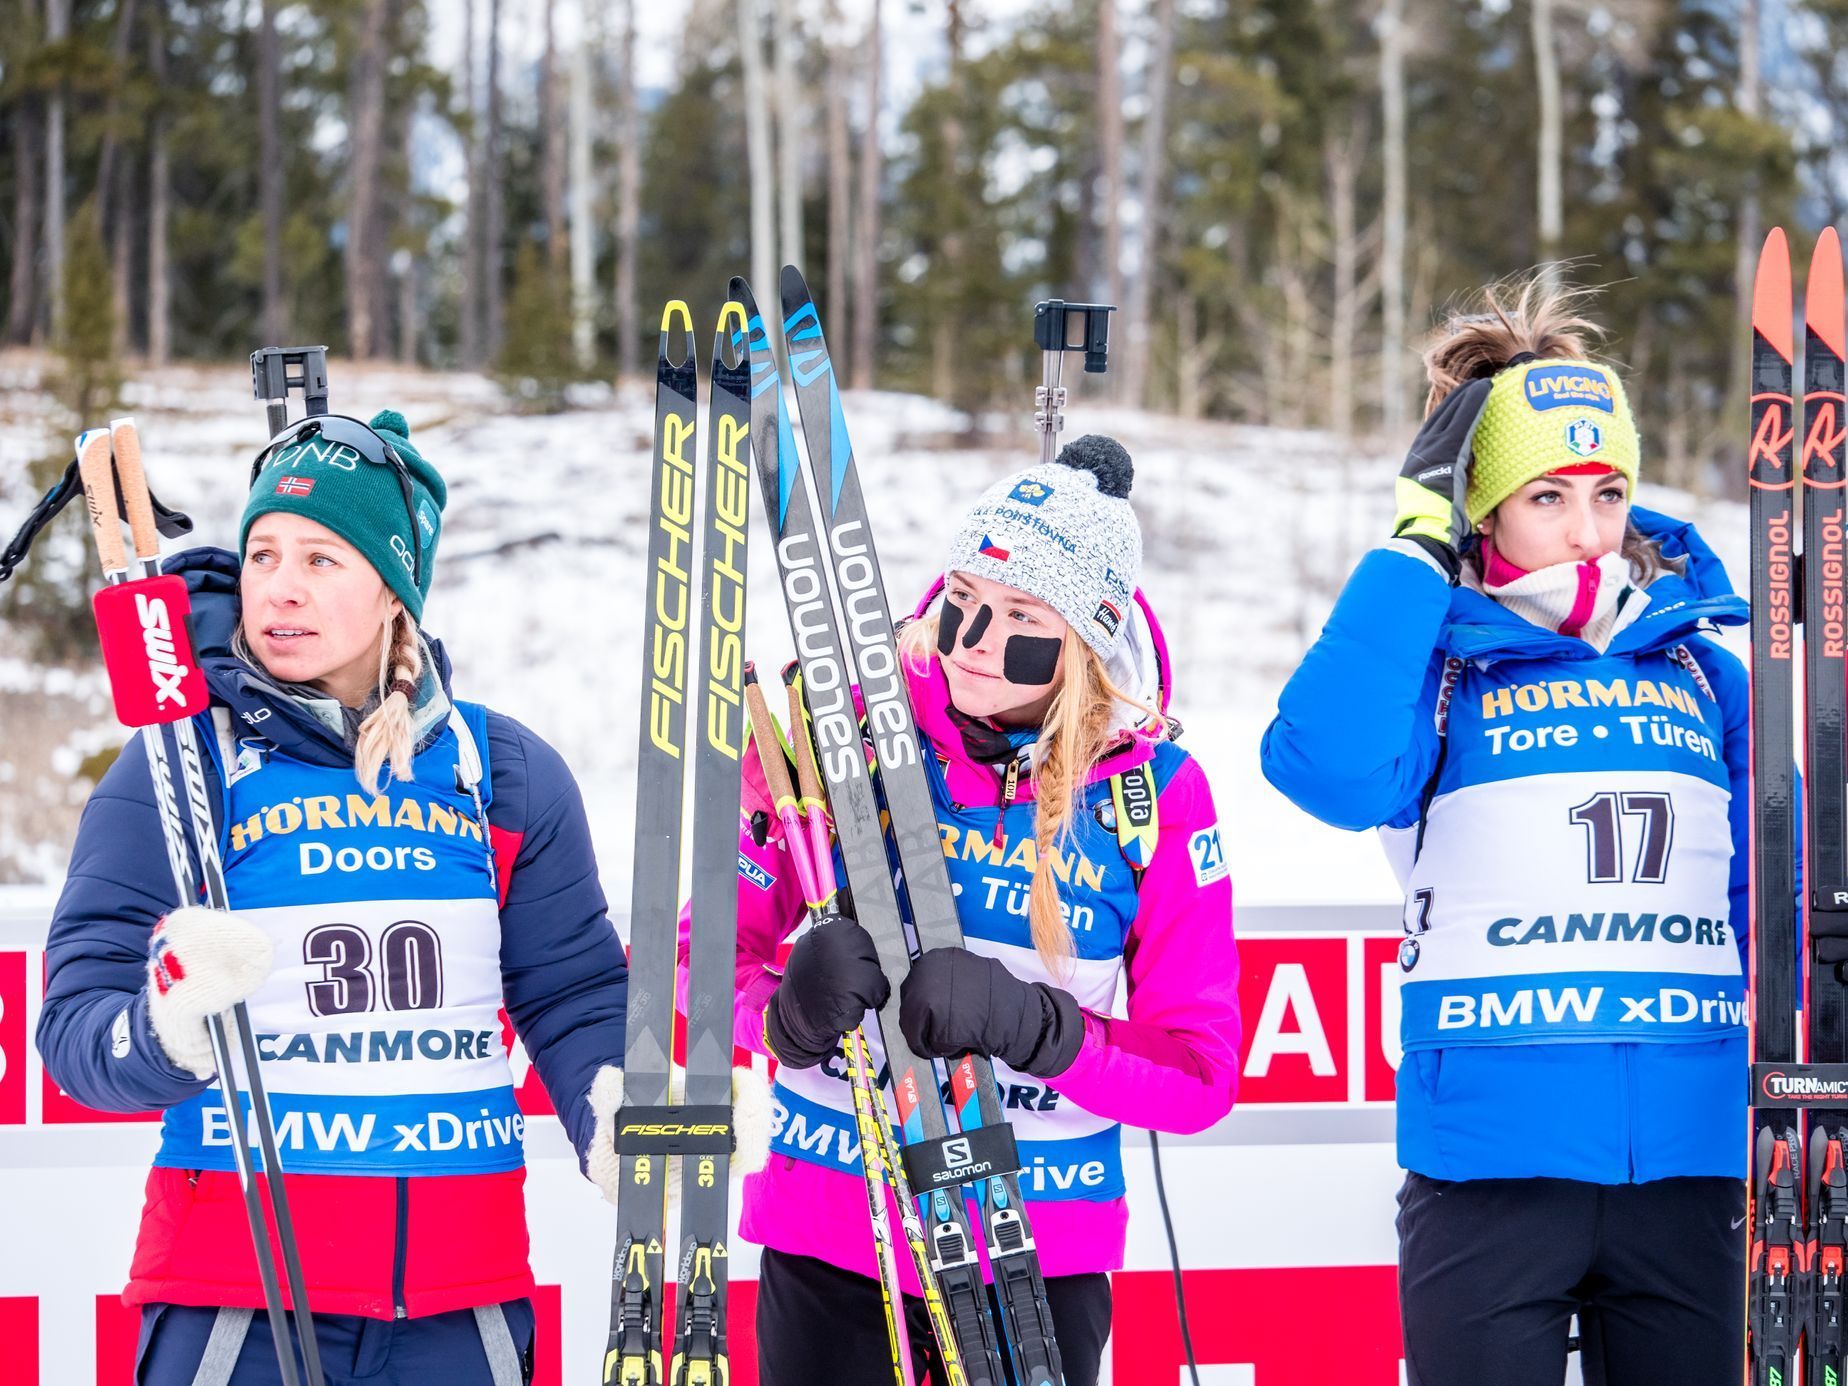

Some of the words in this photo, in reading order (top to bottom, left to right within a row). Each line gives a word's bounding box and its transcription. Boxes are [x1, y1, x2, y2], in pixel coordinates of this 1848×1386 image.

[1528, 376, 1611, 400] LIVIGNO
[650, 413, 695, 760] FISCHER
[707, 414, 749, 761] FISCHER
[1768, 510, 1790, 659] ROSSIGNOL
[1822, 509, 1844, 657] ROSSIGNOL
[1481, 679, 1705, 723] HÖRMANN
[1484, 725, 1578, 755] Tore
[1619, 716, 1717, 761] Türen
[231, 794, 484, 852] HÖRMANN
[1569, 792, 1675, 884] 17
[299, 842, 437, 876] Doors
[938, 824, 1105, 892] RMANN
[981, 876, 1094, 931] Tüen
[1486, 912, 1727, 947] CANMORE
[302, 920, 443, 1018] 30
[1438, 987, 1604, 1030] BMW
[255, 1029, 494, 1063] CANMORE
[201, 1107, 376, 1152] BMW
[392, 1108, 525, 1152] xDrive
[620, 1124, 729, 1136] FISCHER
[854, 1087, 884, 1182] LEKI
[635, 1158, 651, 1186] 3D
[698, 1160, 715, 1188] 3D
[1018, 1156, 1105, 1192] rive
